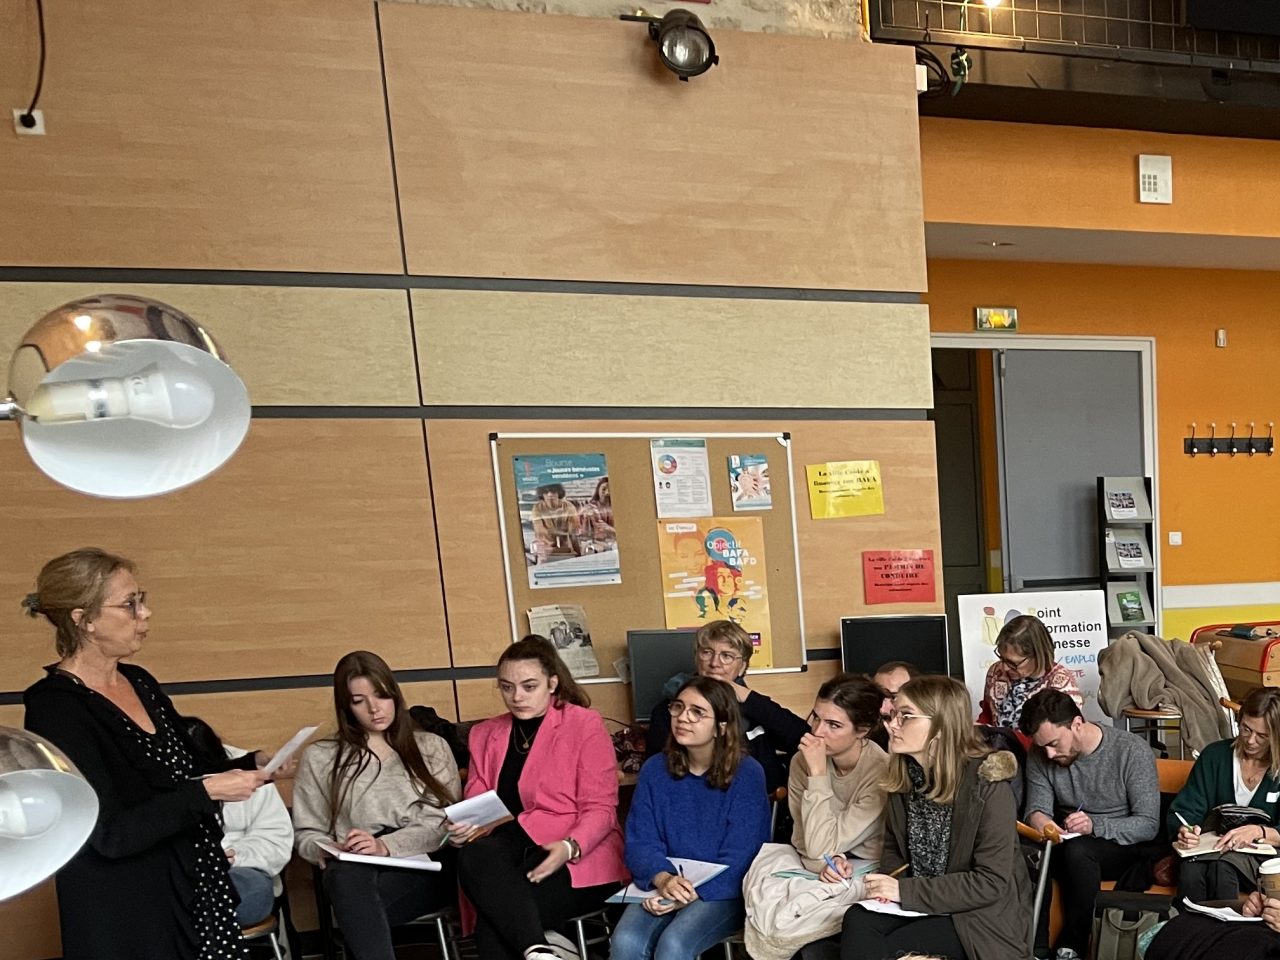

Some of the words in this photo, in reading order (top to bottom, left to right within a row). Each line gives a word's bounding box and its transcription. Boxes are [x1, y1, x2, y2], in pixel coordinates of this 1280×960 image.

[707, 540, 741, 551] Objectif
[722, 549, 749, 557] BAFA
[729, 557, 757, 565] BAFD
[1048, 622, 1102, 634] ormation
[1054, 639, 1091, 648] nesse
[1065, 655, 1096, 664] EMPLO
